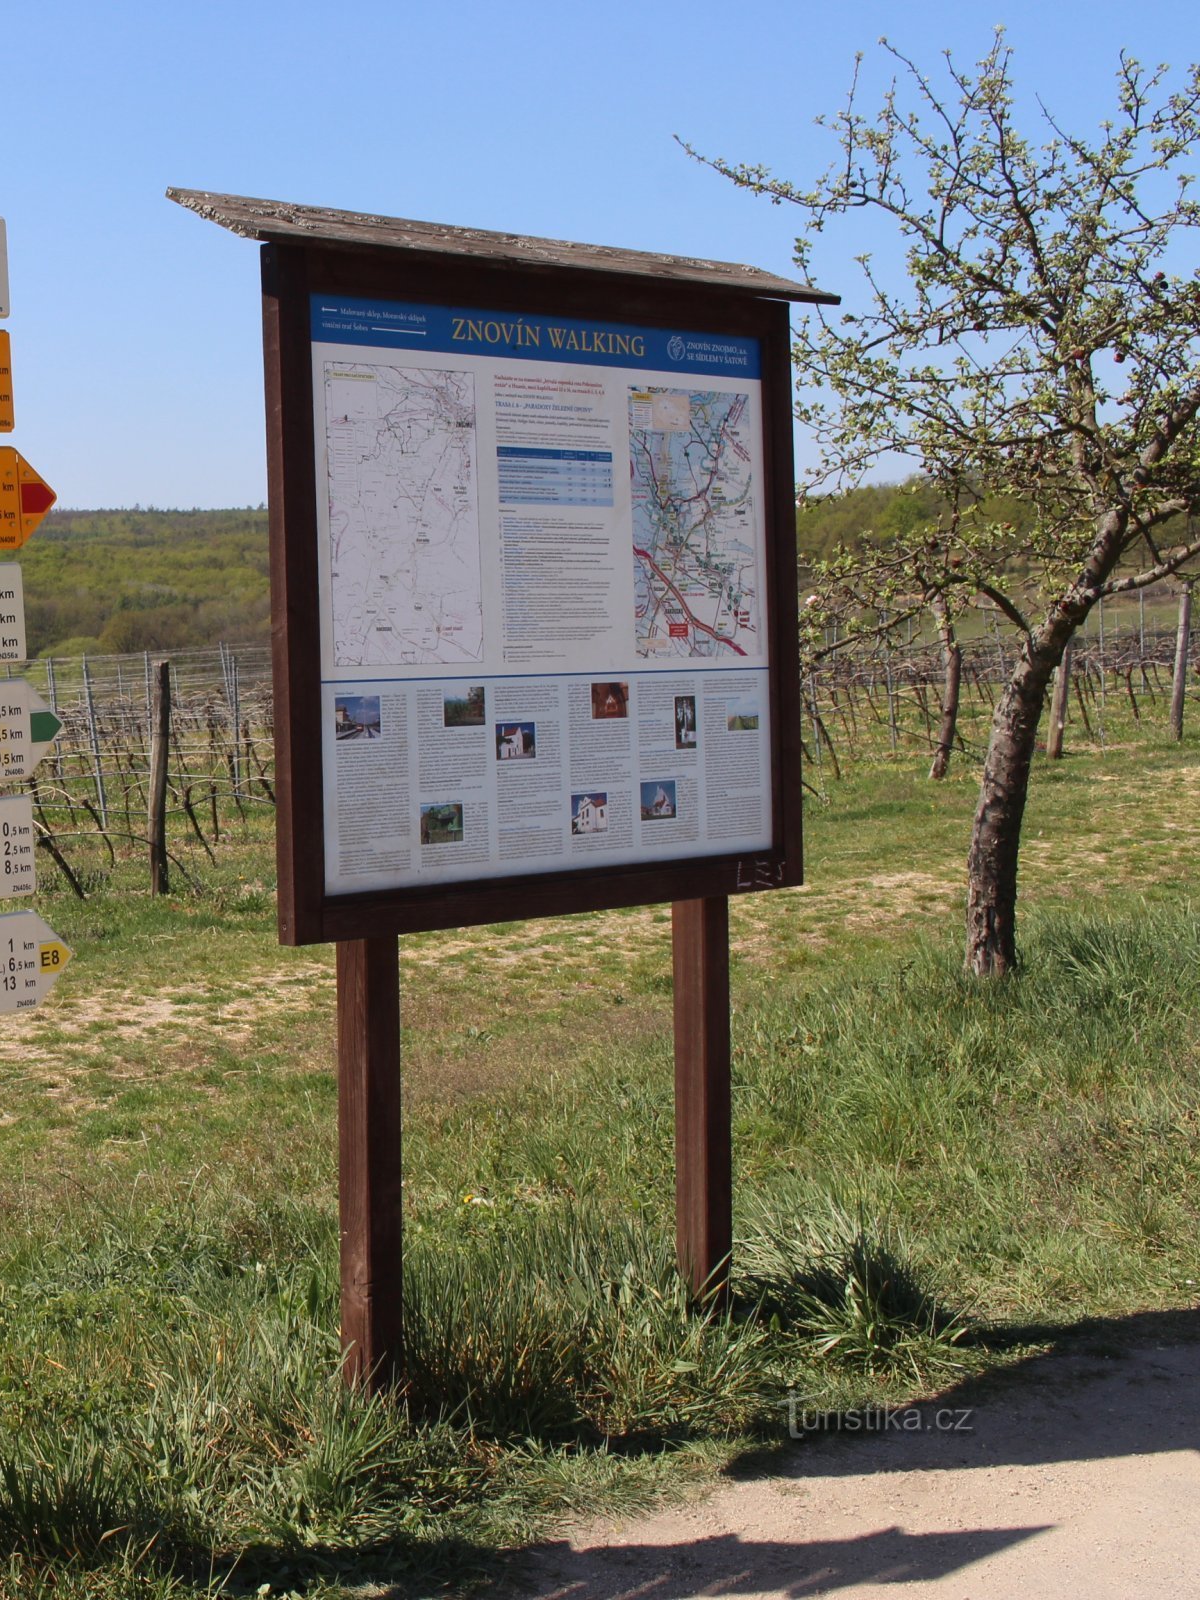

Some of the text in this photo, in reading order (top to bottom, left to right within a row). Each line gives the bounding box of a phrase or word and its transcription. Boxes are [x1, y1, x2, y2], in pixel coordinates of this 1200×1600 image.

[452, 318, 645, 357] ZNOVÍN WALKING
[686, 341, 711, 351] ZNOVÍN
[687, 352, 695, 360] SE
[2, 482, 14, 492] km
[4, 509, 15, 519] km
[0, 613, 16, 624] km
[2, 637, 18, 648] km
[8, 705, 22, 716] km
[10, 729, 23, 740] km
[11, 753, 24, 764] km
[18, 825, 30, 836] km
[19, 844, 30, 854] km
[20, 863, 32, 873] km
[8, 938, 14, 953] 1
[23, 941, 35, 951] km
[40, 949, 60, 968] E8
[24, 960, 35, 970] km
[3, 977, 17, 992] 13
[25, 978, 36, 989] km
